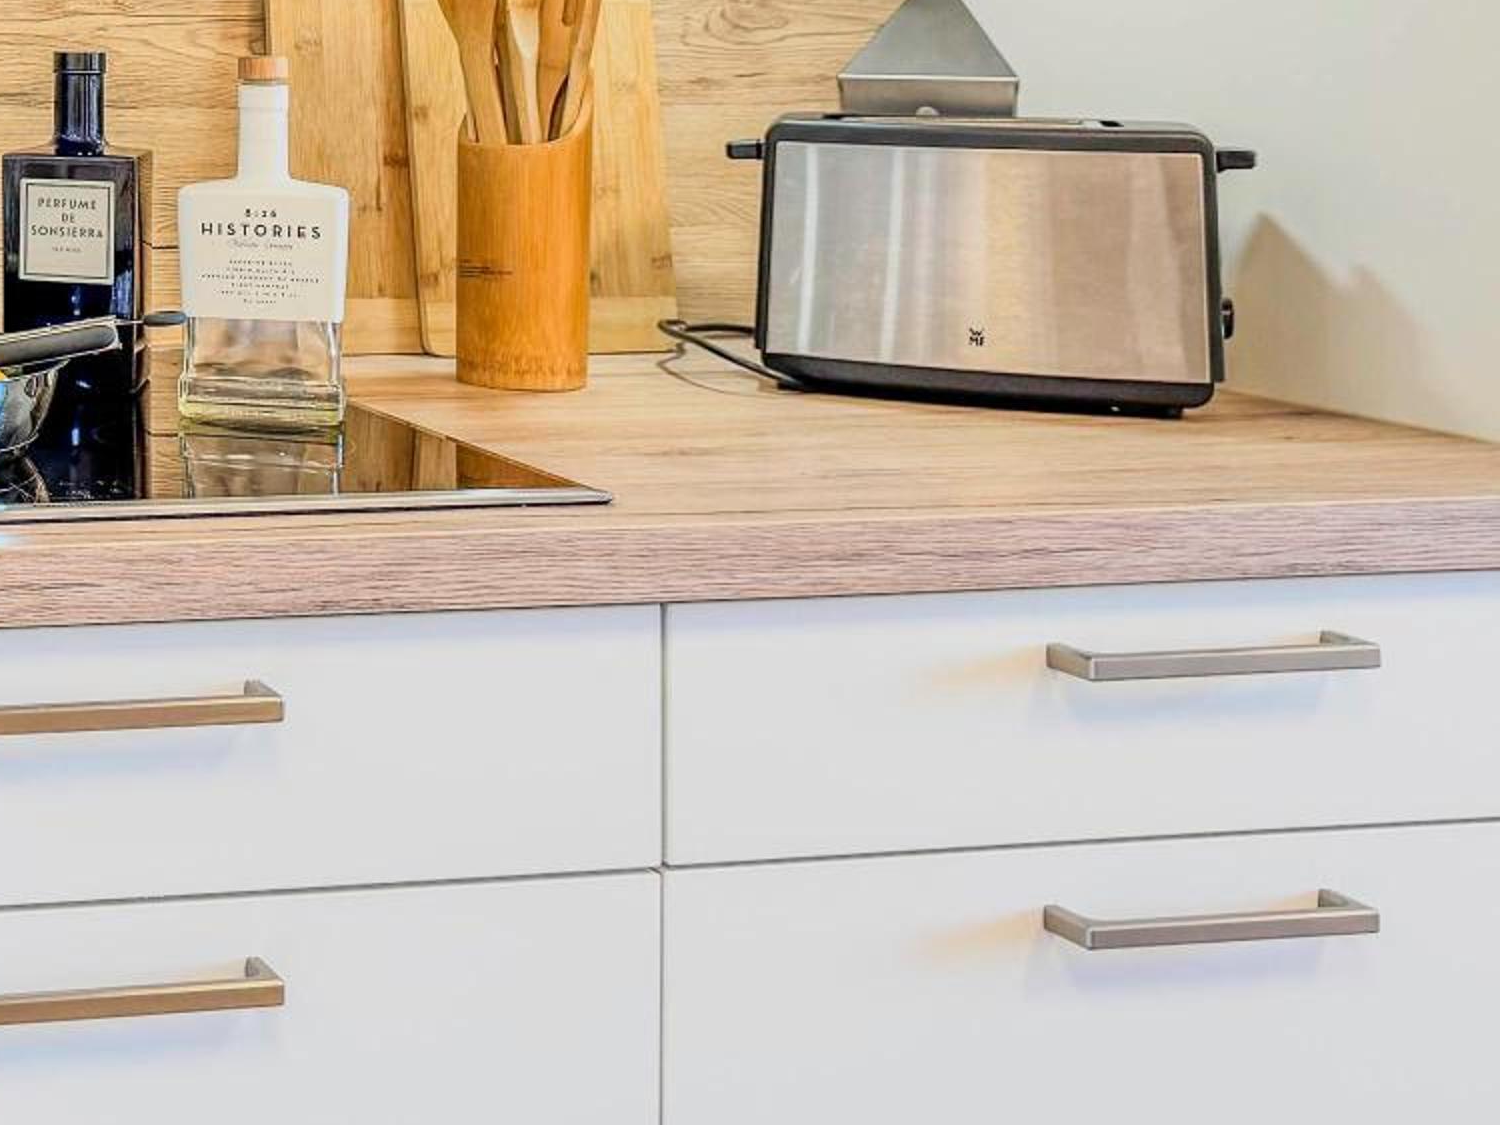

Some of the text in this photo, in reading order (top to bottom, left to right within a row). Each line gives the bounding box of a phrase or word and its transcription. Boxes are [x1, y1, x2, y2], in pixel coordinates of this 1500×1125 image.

[37, 197, 96, 210] PERFUME
[61, 213, 75, 223] DE
[31, 225, 103, 238] SONSIERRA
[201, 222, 321, 239] HISTORIES
